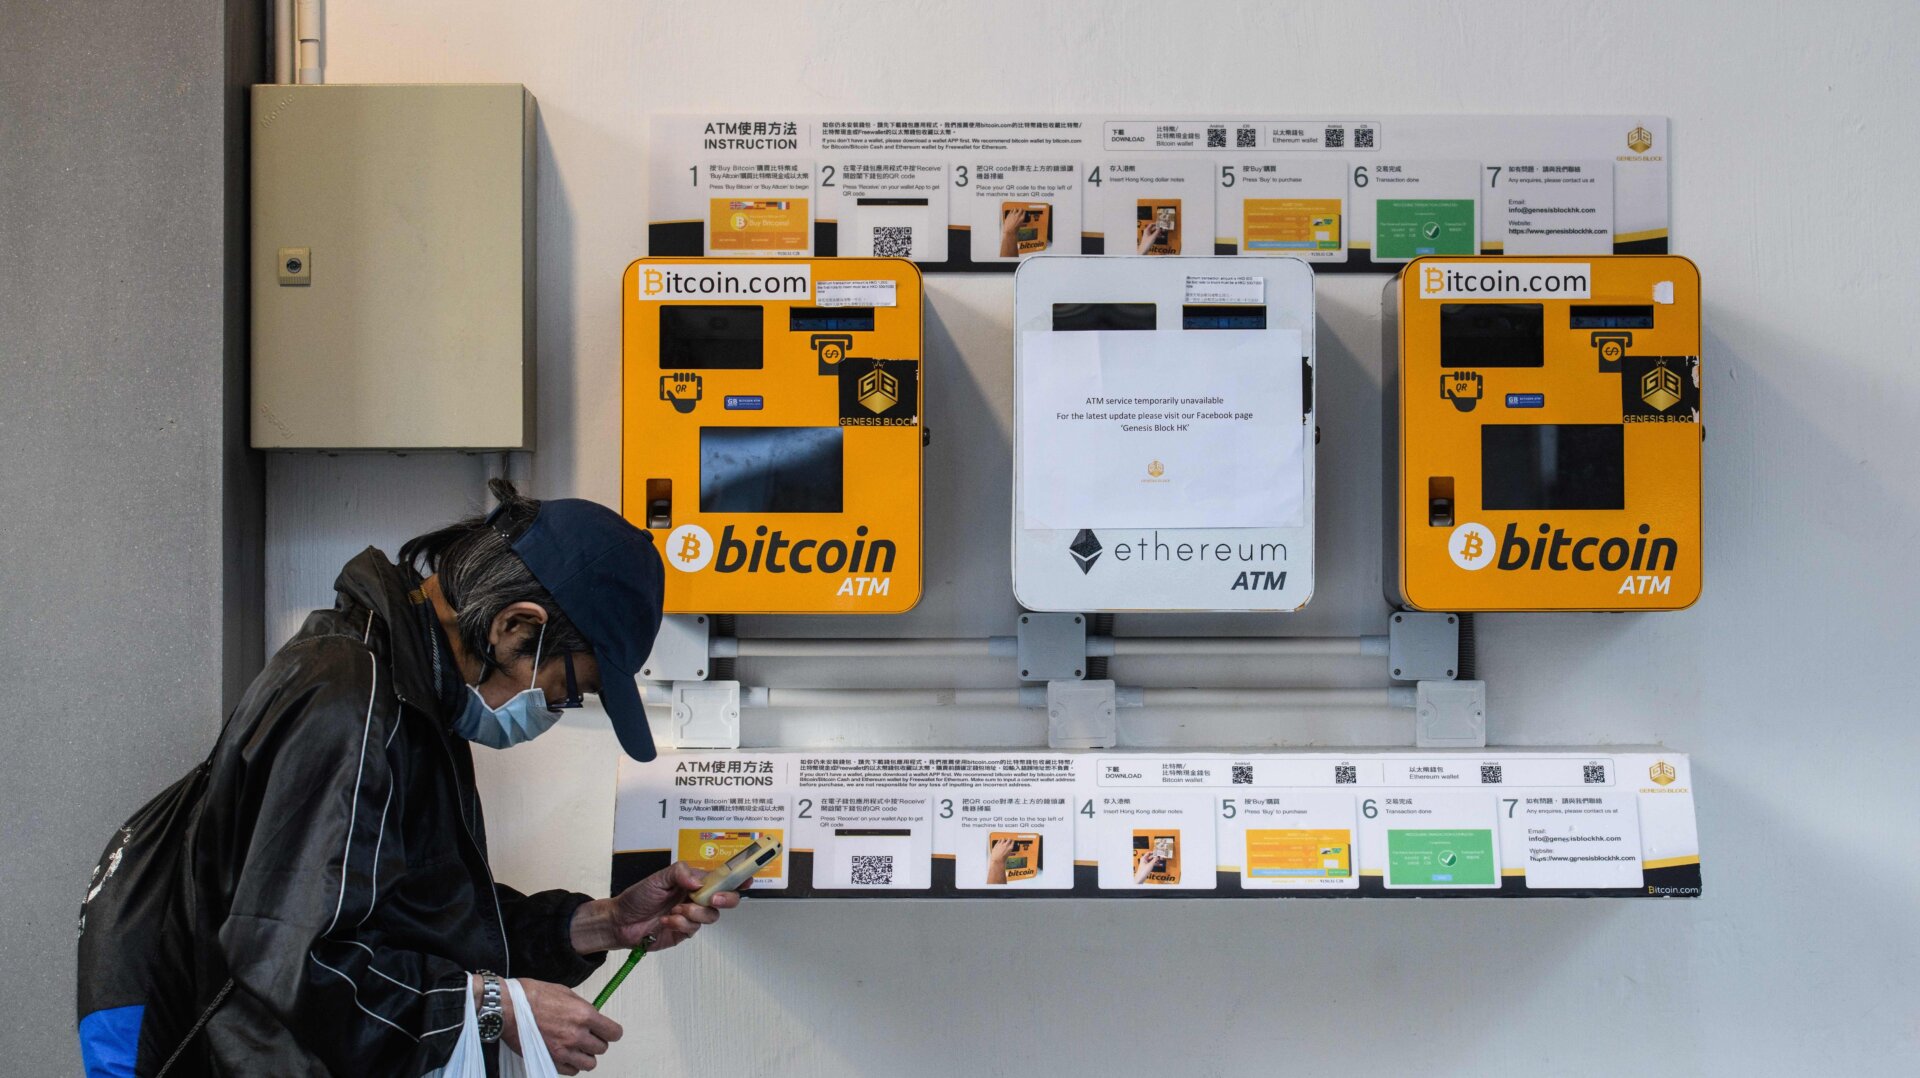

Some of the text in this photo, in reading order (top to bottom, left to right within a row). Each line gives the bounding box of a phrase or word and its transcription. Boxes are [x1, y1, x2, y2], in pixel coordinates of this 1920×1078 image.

[705, 122, 797, 135] ATM使用方法
[704, 138, 797, 150] INSTRUCTION
[689, 165, 698, 187] 1
[821, 165, 836, 187] 2
[955, 165, 969, 188] 3
[1088, 165, 1102, 188] 4
[1222, 166, 1235, 188] 5
[1354, 165, 1369, 188] 6
[1376, 165, 1402, 173] 交易完成
[1486, 166, 1502, 188] 7
[643, 269, 806, 296] Bitcoin.com
[1424, 267, 1586, 294] Bitcoin.com
[675, 384, 687, 394] QR
[1456, 383, 1467, 392] QR
[1086, 397, 1104, 405] ATM
[839, 418, 881, 426] GENESIS
[1164, 412, 1180, 420] visit
[1234, 412, 1254, 420] page
[1623, 414, 1694, 423] GENESIS BLOC
[714, 524, 896, 573] bitcoin
[1114, 530, 1287, 561] ethereum
[1498, 522, 1678, 571] bitcoin
[836, 577, 890, 596] ATM
[1230, 571, 1287, 590] ATM
[1618, 576, 1671, 594] ATM
[676, 761, 773, 773] ATM使用方法
[675, 776, 773, 786] INSTRUCTIONS
[658, 798, 667, 819] 1
[798, 798, 813, 819] 2
[939, 798, 954, 819] 3
[1080, 798, 1096, 819] 4
[1222, 799, 1237, 819] 5
[1362, 799, 1379, 819] 6
[1502, 798, 1519, 819] 7
[1008, 869, 1034, 878] bitcoin
[1147, 874, 1175, 882] itcoin
[1648, 886, 1699, 894] Bitcoin.com
